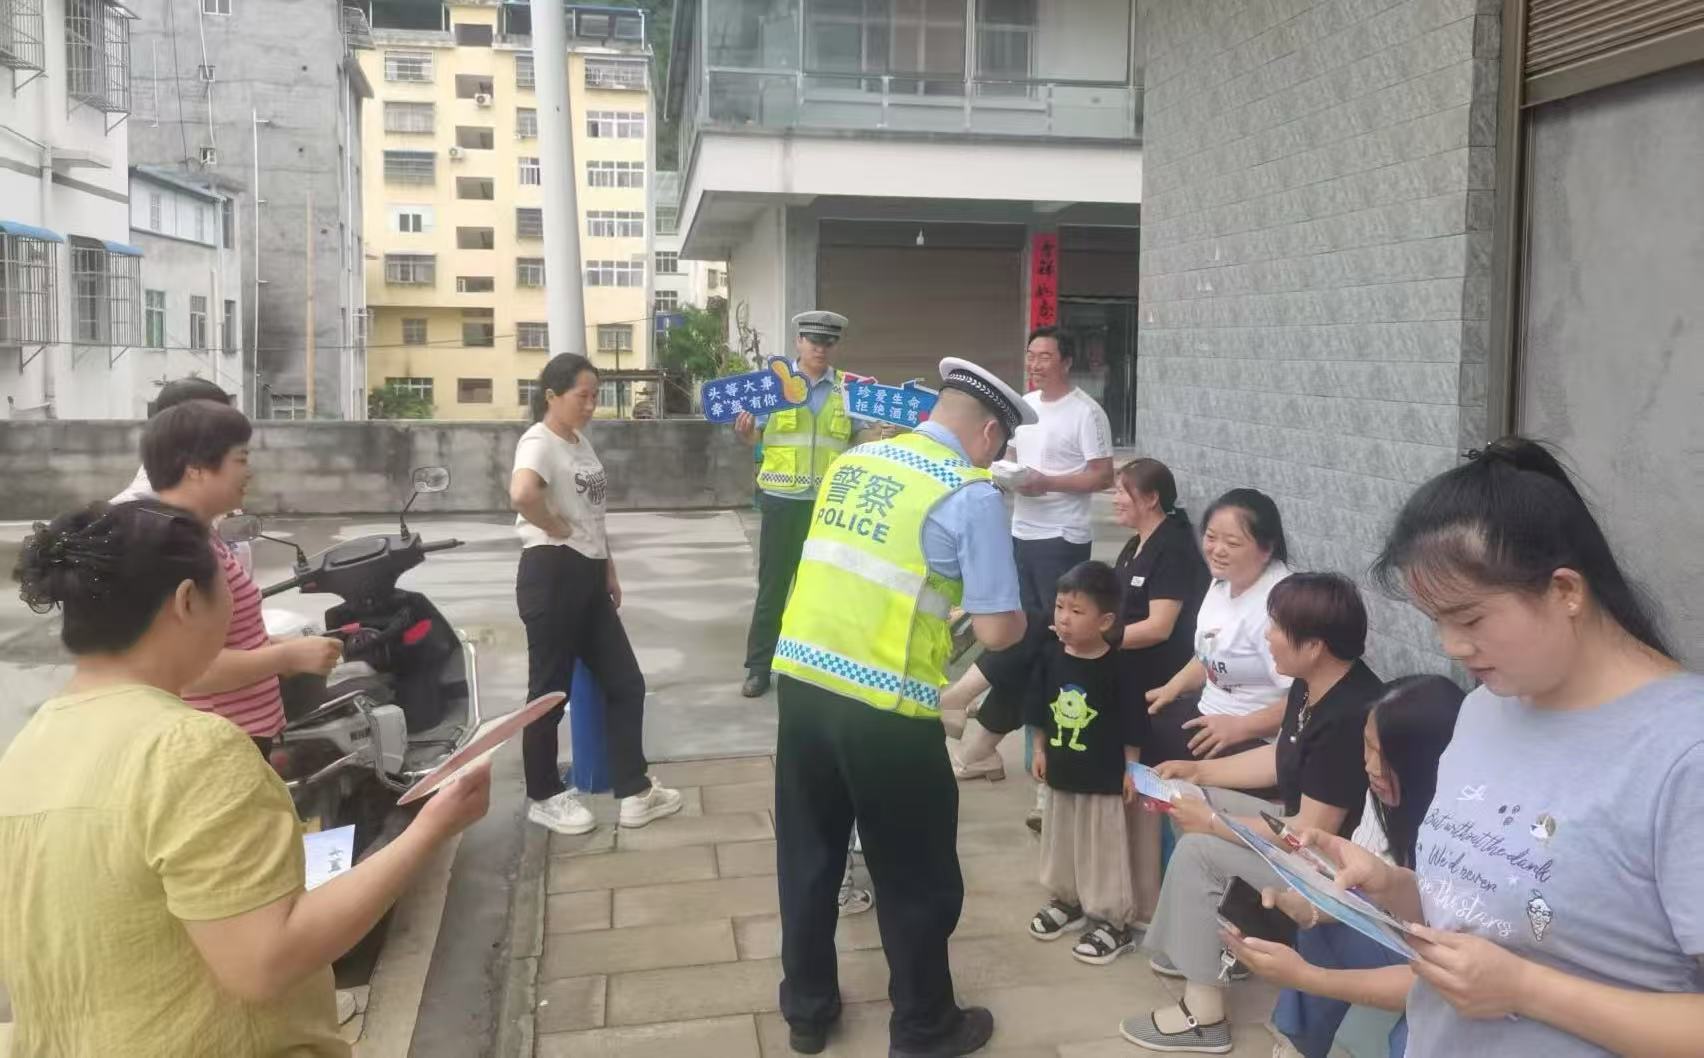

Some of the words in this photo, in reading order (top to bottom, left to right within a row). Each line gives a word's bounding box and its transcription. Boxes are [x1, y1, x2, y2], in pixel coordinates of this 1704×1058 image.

[708, 375, 775, 401] 头等大事
[856, 386, 921, 410] 珍爱生命
[855, 399, 919, 425] 拒绝酒驾
[826, 464, 905, 518] 警察
[815, 507, 891, 545] POLICE
